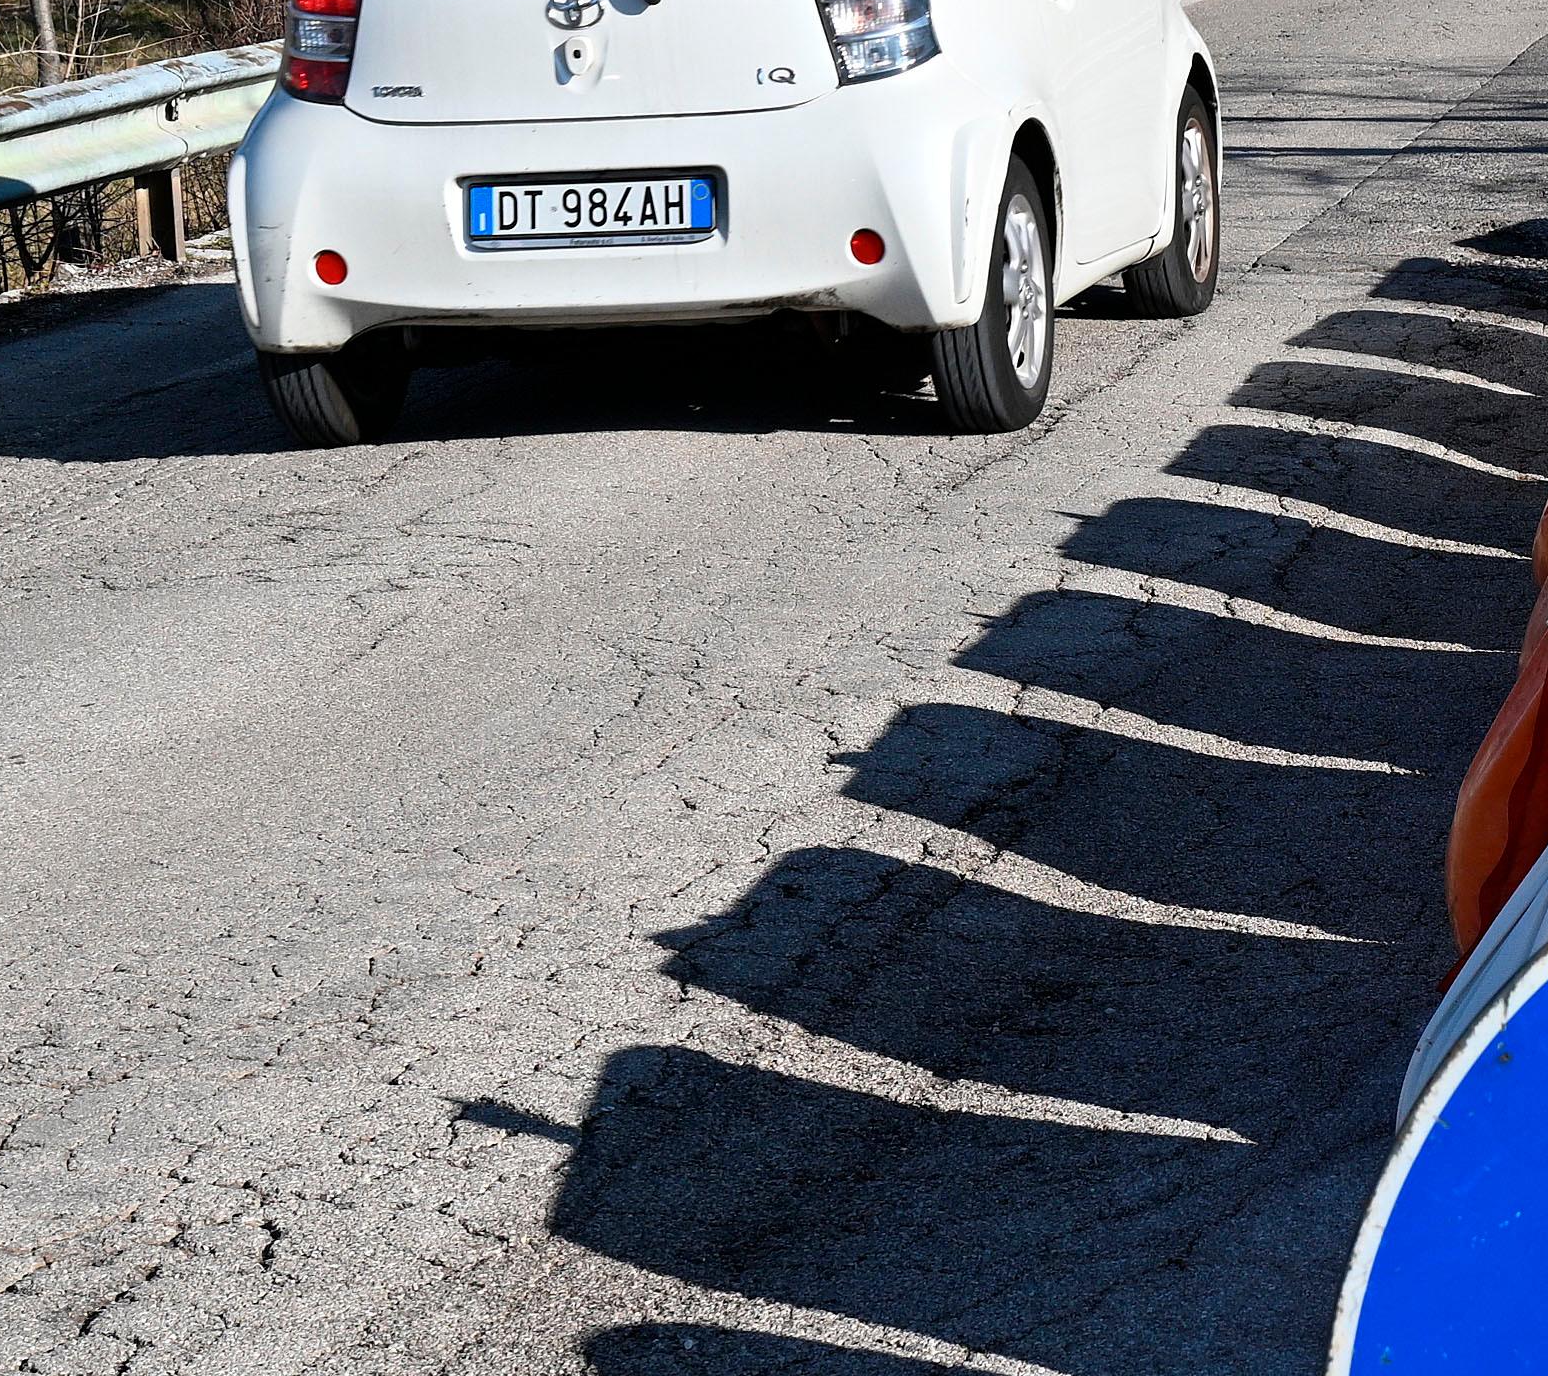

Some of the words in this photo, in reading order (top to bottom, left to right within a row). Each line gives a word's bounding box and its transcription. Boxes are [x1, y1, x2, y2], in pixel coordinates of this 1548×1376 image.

[371, 86, 424, 98] TOYOTA
[499, 190, 543, 231] DT
[562, 184, 684, 228] 984AH
